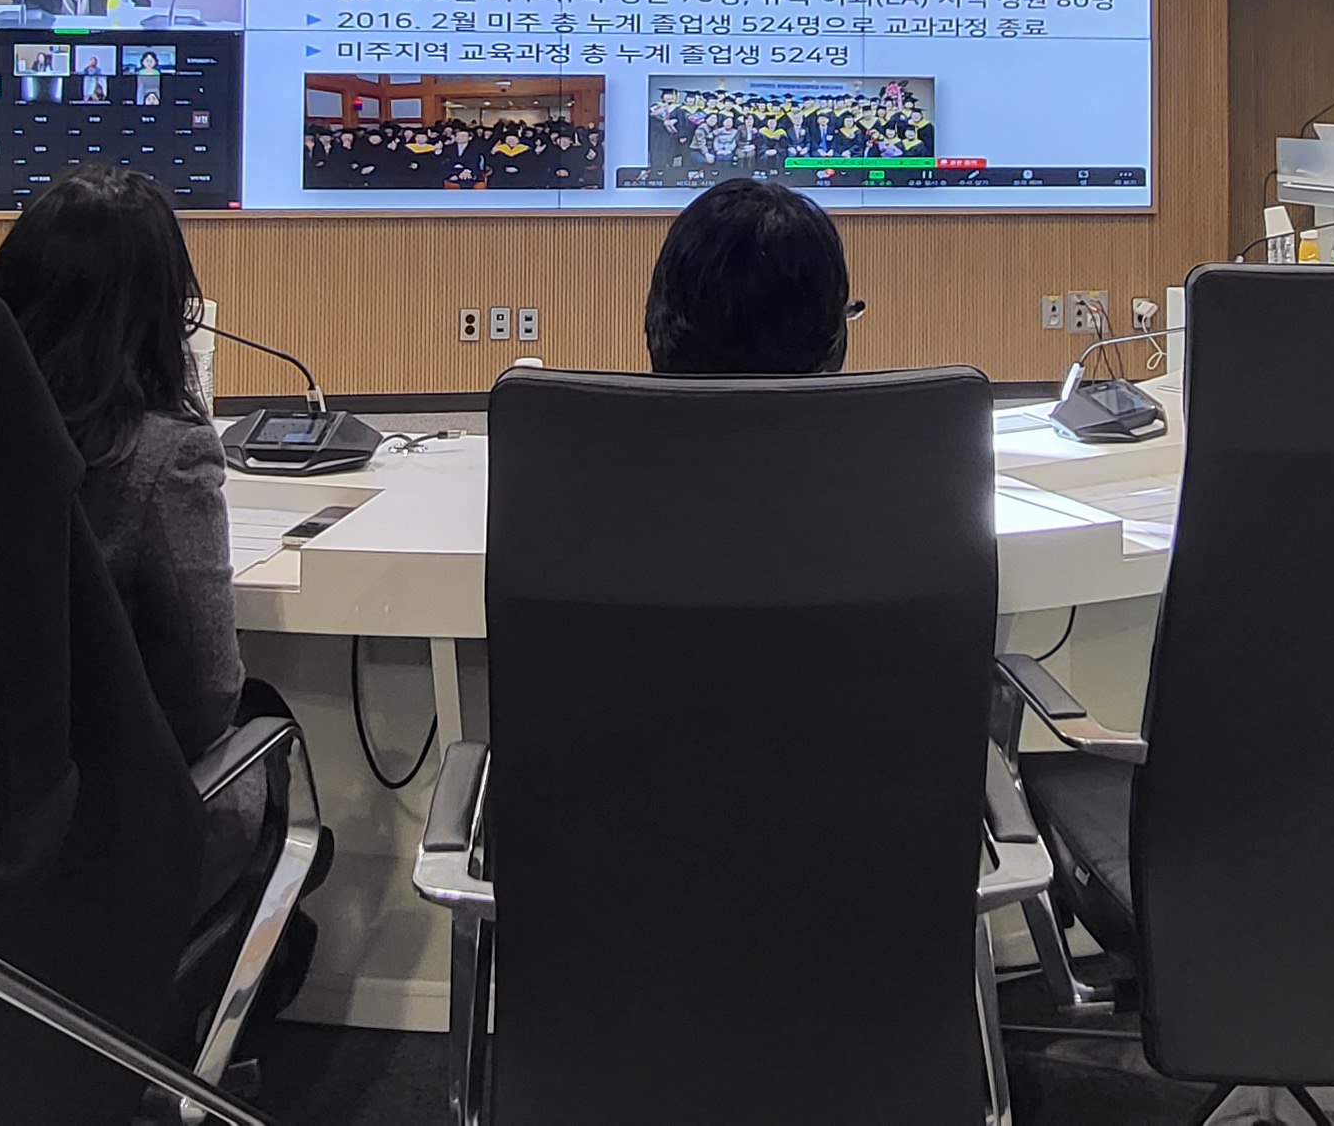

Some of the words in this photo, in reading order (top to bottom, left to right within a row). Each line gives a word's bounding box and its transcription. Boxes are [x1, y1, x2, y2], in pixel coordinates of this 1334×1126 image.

[337, 11, 421, 30] 2016.
[431, 11, 476, 33] 2월
[488, 12, 543, 33] 미주
[551, 12, 579, 34] 총
[586, 13, 641, 34] 누계
[651, 14, 731, 35] 졸업생
[742, 15, 876, 36] 524명으로
[884, 17, 988, 38] 교과과정
[997, 18, 1049, 38] 종료
[337, 41, 448, 62] 미주지역
[458, 42, 571, 64] 교육과정
[580, 43, 609, 64] 총
[616, 43, 670, 64] 누계
[679, 44, 760, 65] 졸업생
[770, 45, 849, 66] 524명
